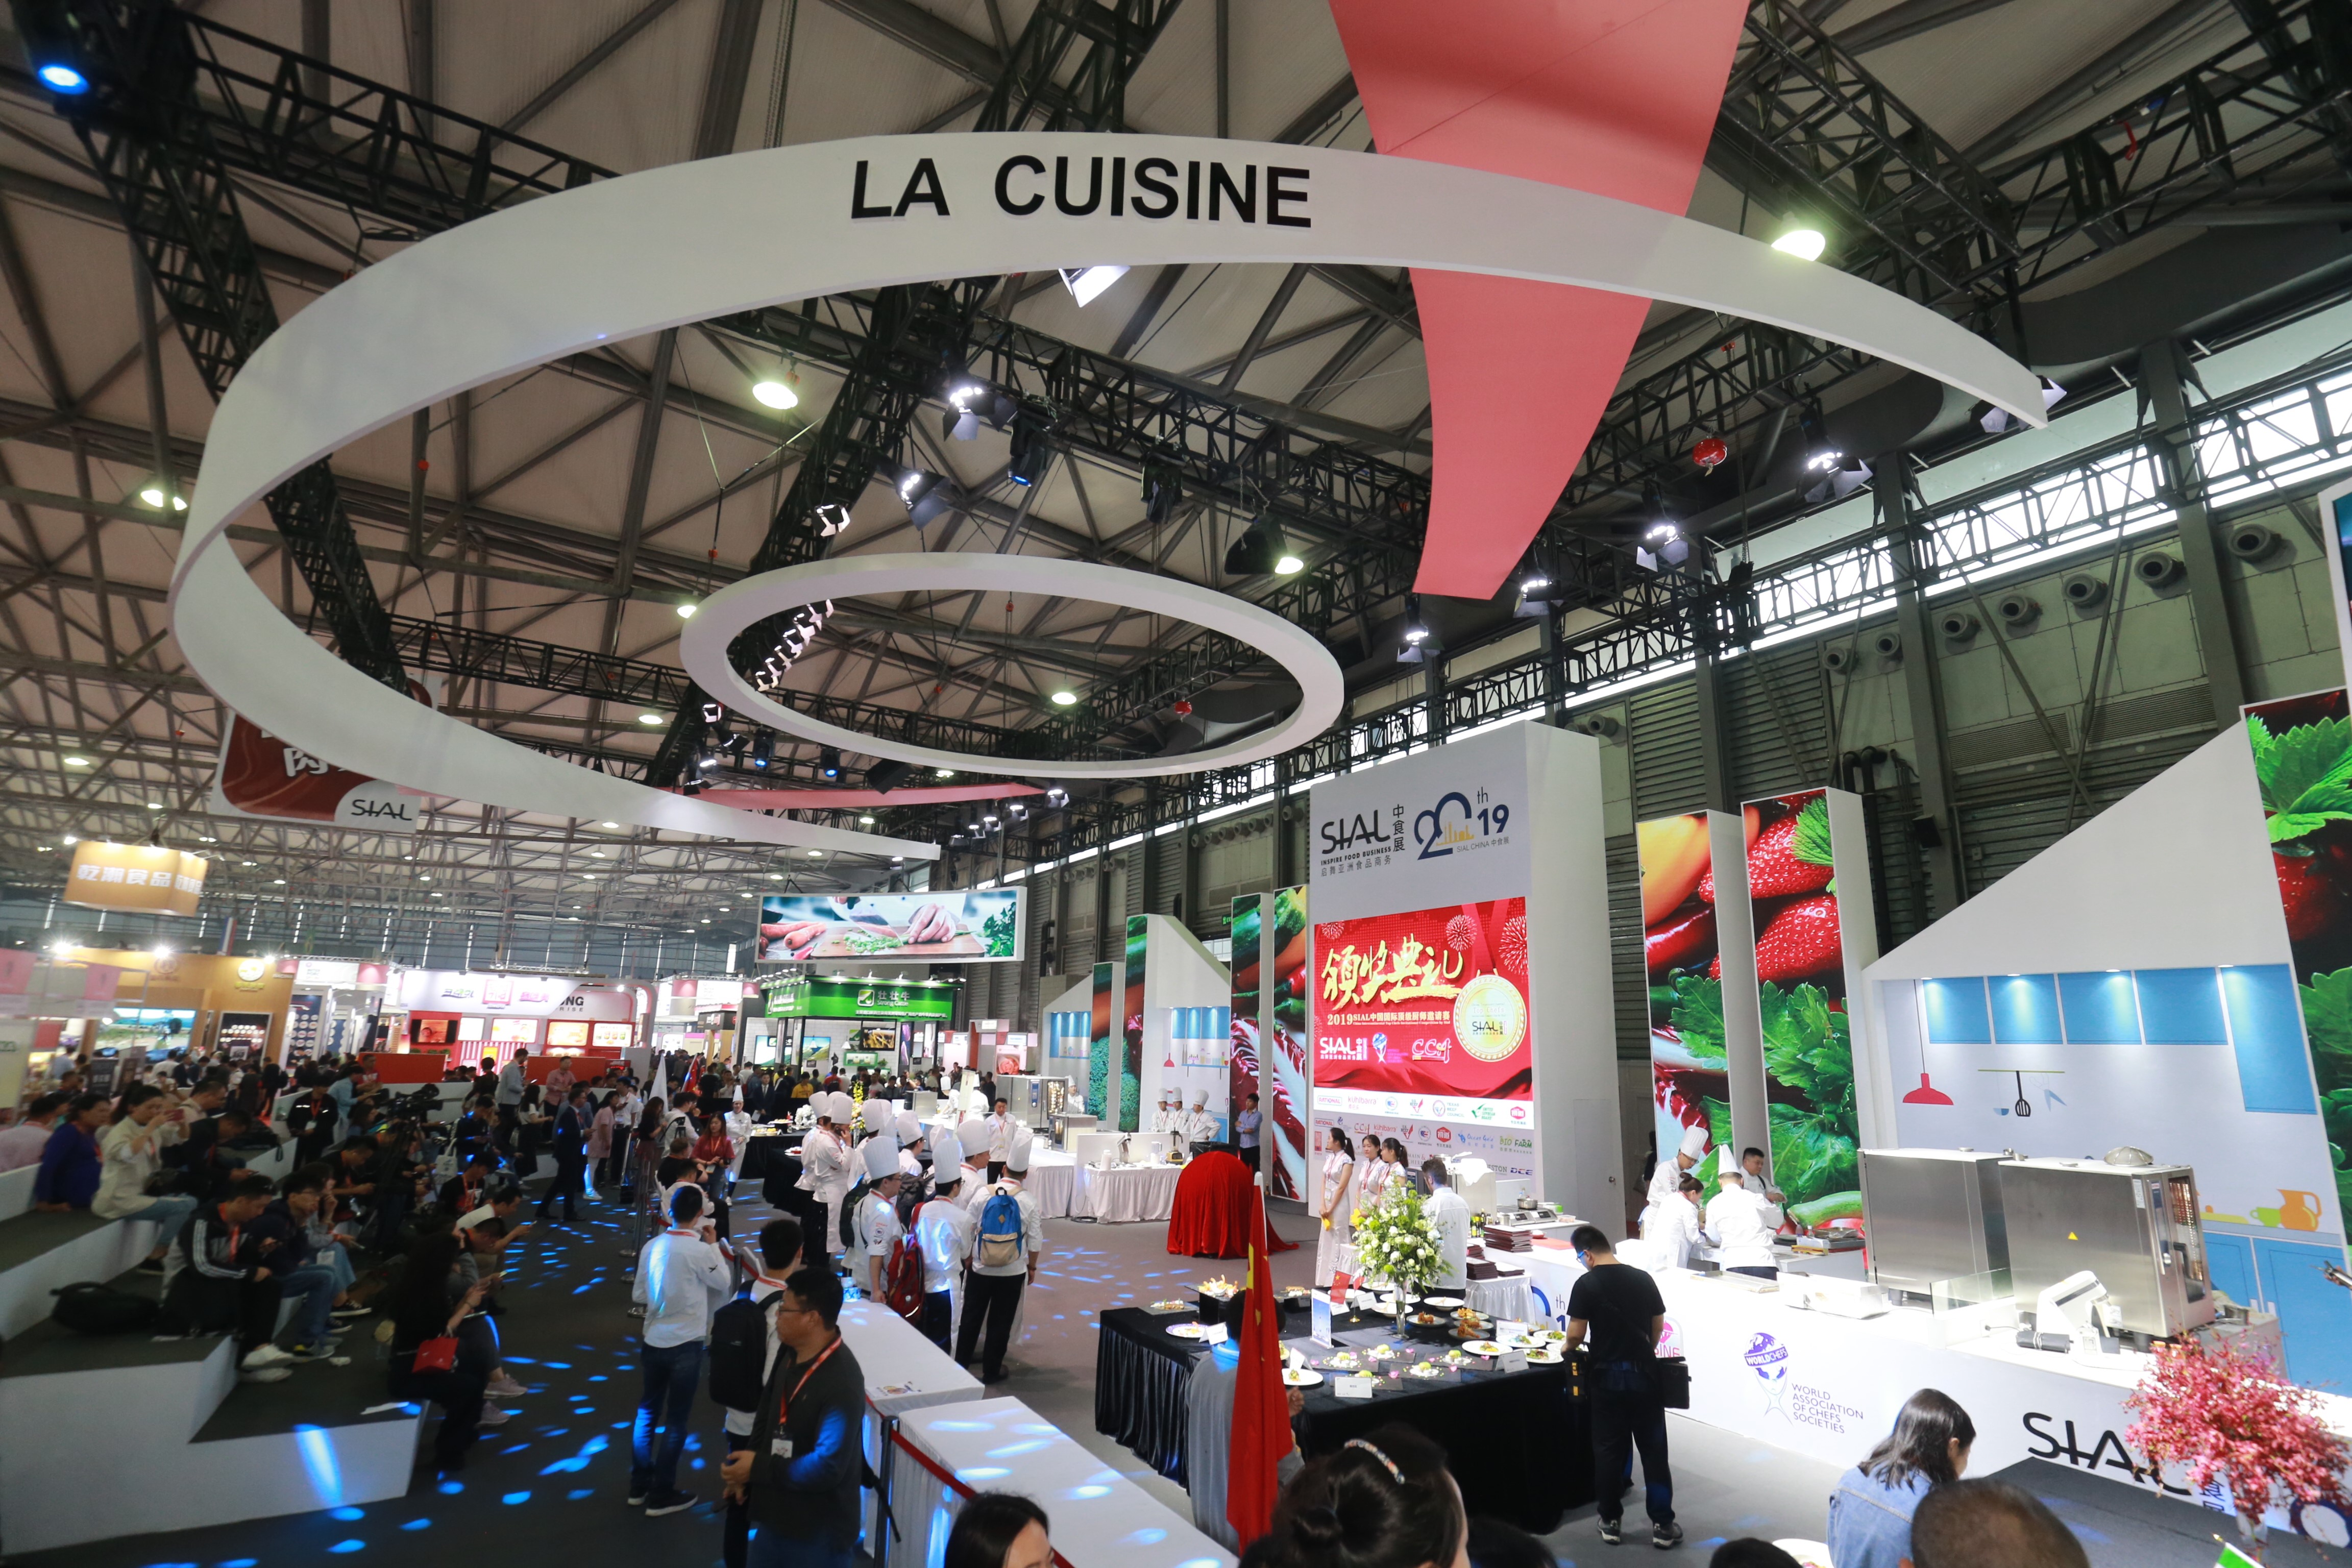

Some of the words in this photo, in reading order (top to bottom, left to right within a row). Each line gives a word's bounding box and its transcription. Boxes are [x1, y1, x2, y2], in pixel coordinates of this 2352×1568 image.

[851, 158, 949, 218] LA
[995, 155, 1311, 228] CUISINE
[351, 799, 412, 821] SIAL
[1477, 804, 1509, 836] 19
[1321, 810, 1391, 854] SIAL
[1392, 804, 1405, 852] 中食展
[1471, 841, 1489, 850] CHINA
[1321, 856, 1342, 866] INSPIRE
[1344, 853, 1360, 861] FOOD
[1362, 846, 1391, 857] BUSINESS
[1472, 1021, 1499, 1032] SIAL
[1319, 1037, 1356, 1054] SIAL
[1500, 1136, 1512, 1146] BIO
[1514, 1139, 1532, 1148] FARM
[1746, 1348, 1787, 1366] WORLDCHEFS
[1792, 1383, 1830, 1400] WORLD
[1793, 1393, 1864, 1420] ASSOCIATION
[1793, 1403, 1807, 1412] OF
[1809, 1407, 1841, 1423] CHEFS
[1793, 1412, 1845, 1434] SOCIETIES
